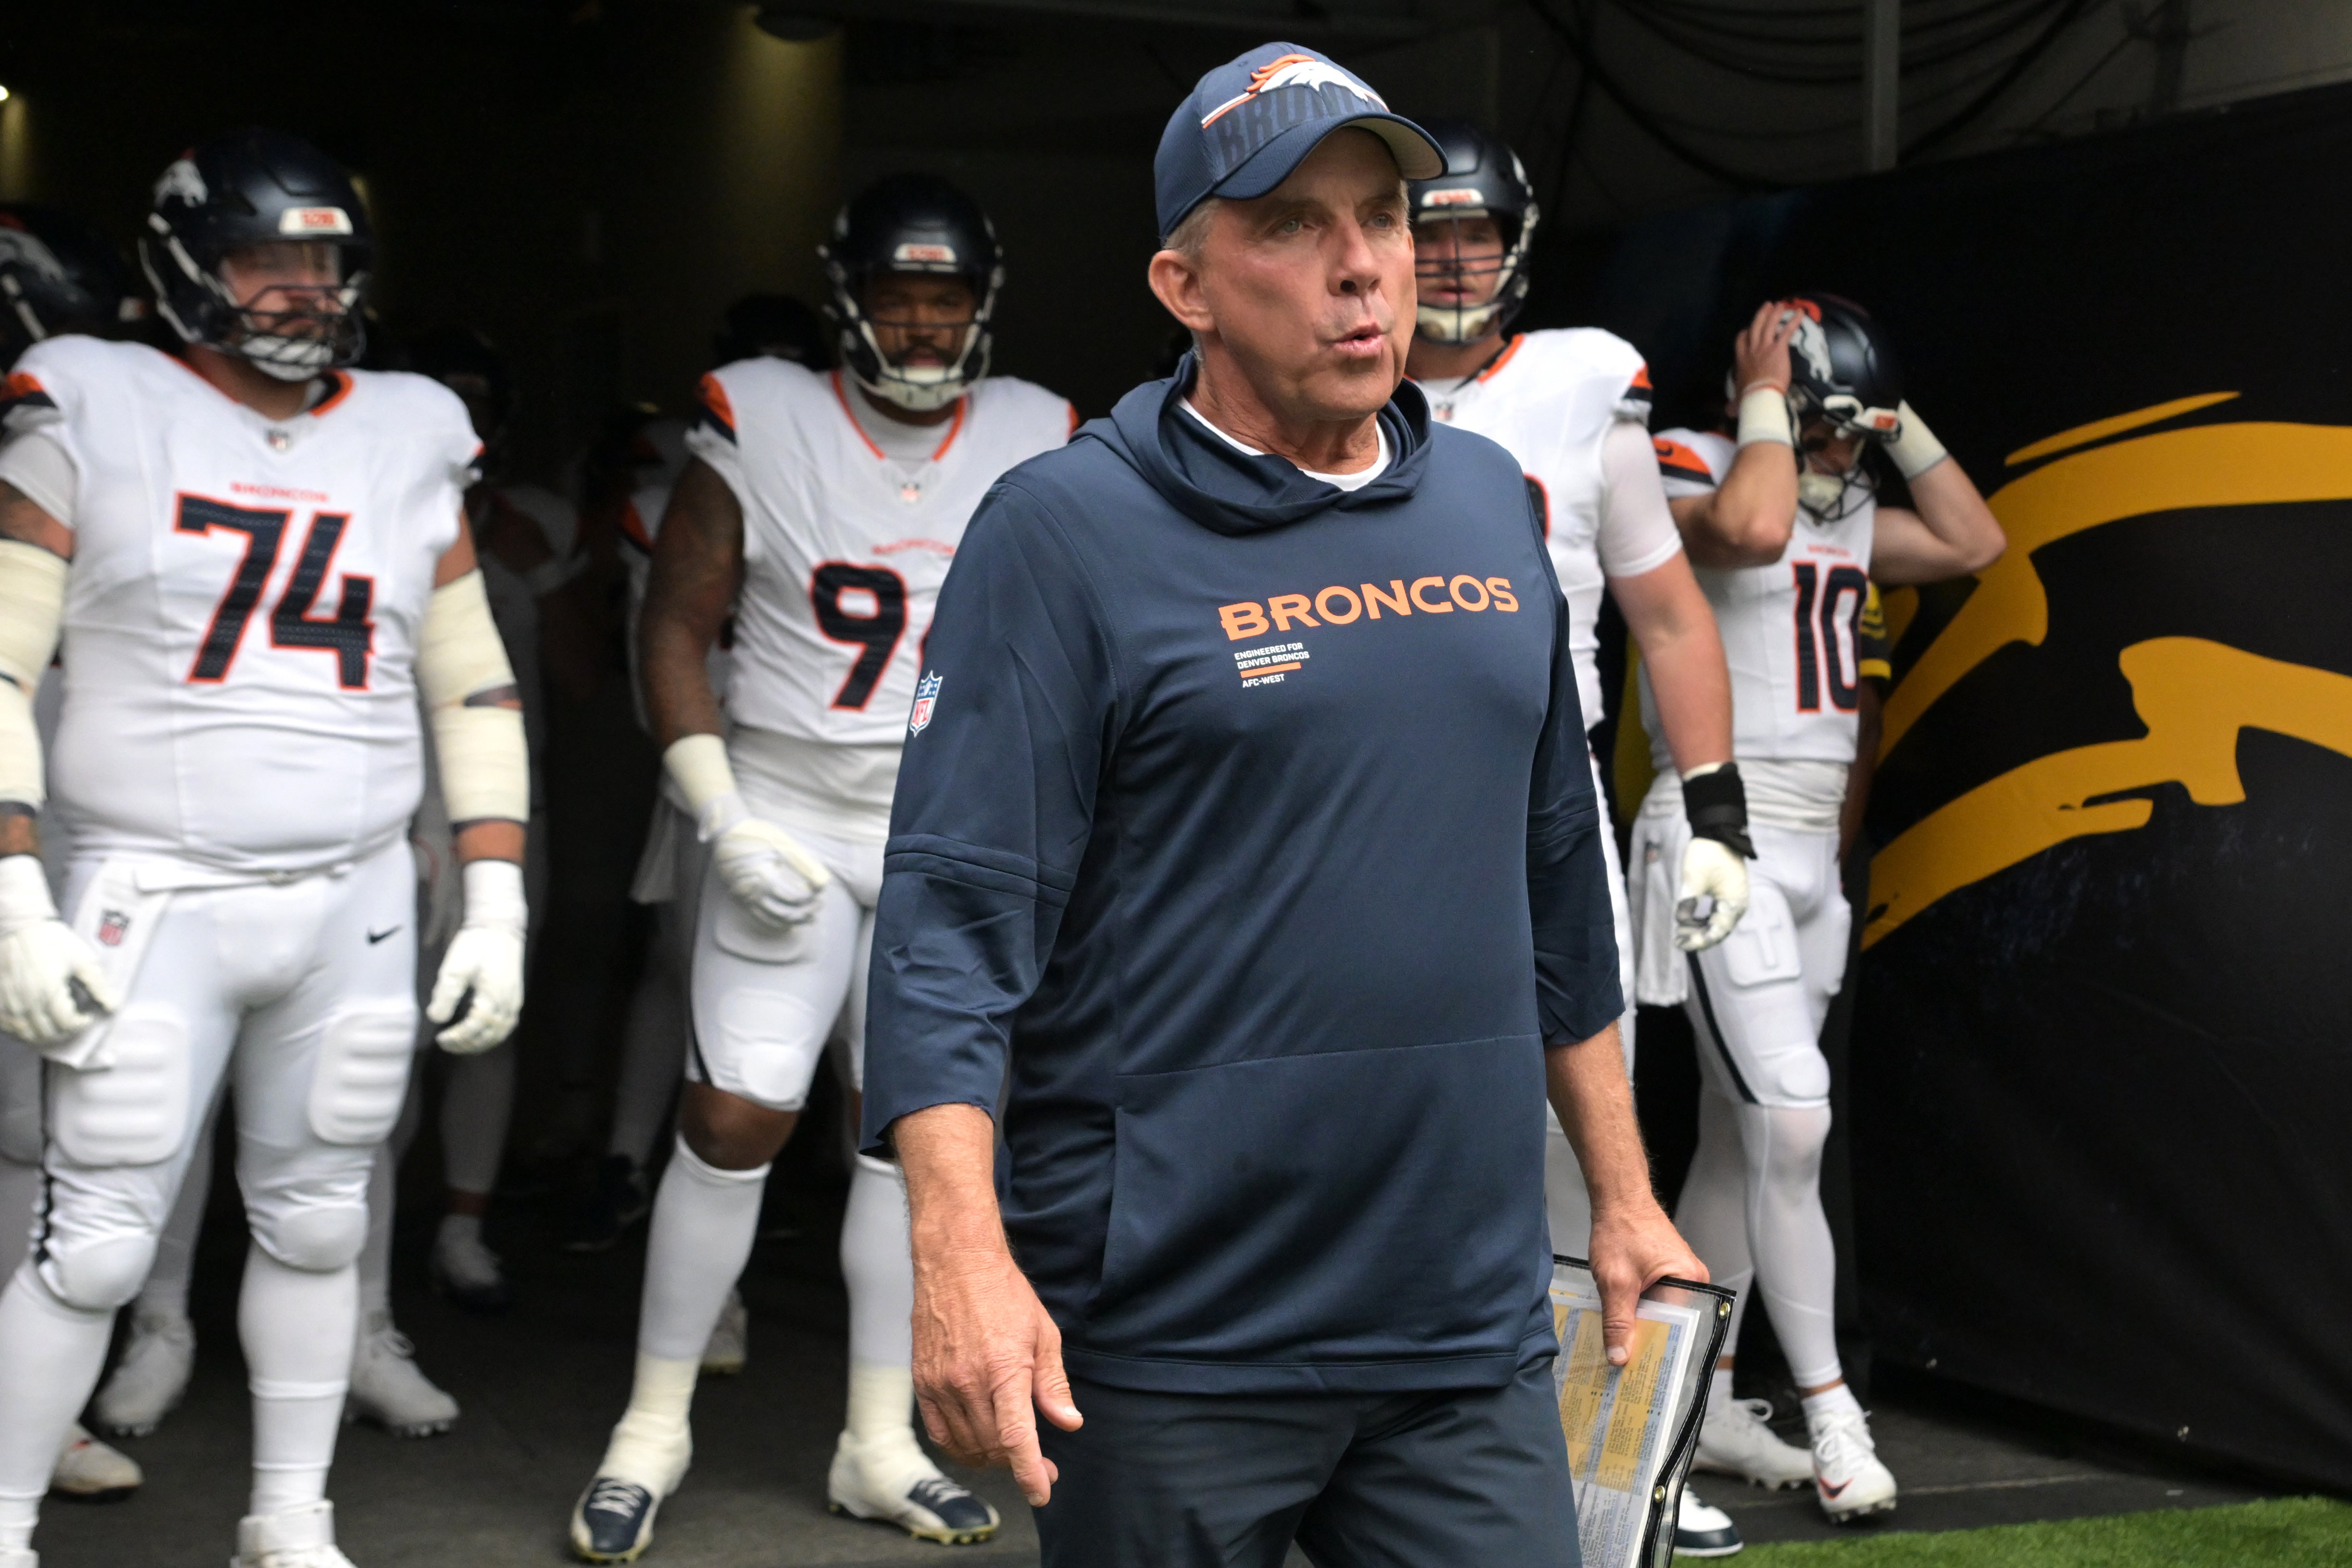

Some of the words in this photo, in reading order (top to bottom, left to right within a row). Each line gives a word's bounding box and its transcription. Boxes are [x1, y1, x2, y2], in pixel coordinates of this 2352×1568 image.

[174, 490, 376, 691] 74
[1218, 574, 1519, 641] BRONCOS
[809, 560, 935, 713] 9
[1234, 644, 1287, 660] ENGINEERED
[1287, 642, 1303, 651] FOR
[1237, 657, 1271, 669] DENVER
[1271, 651, 1310, 663] BRONCOS
[1791, 560, 1869, 714] 10
[1242, 673, 1285, 688] AFC-WEST
[911, 699, 931, 727] NFL
